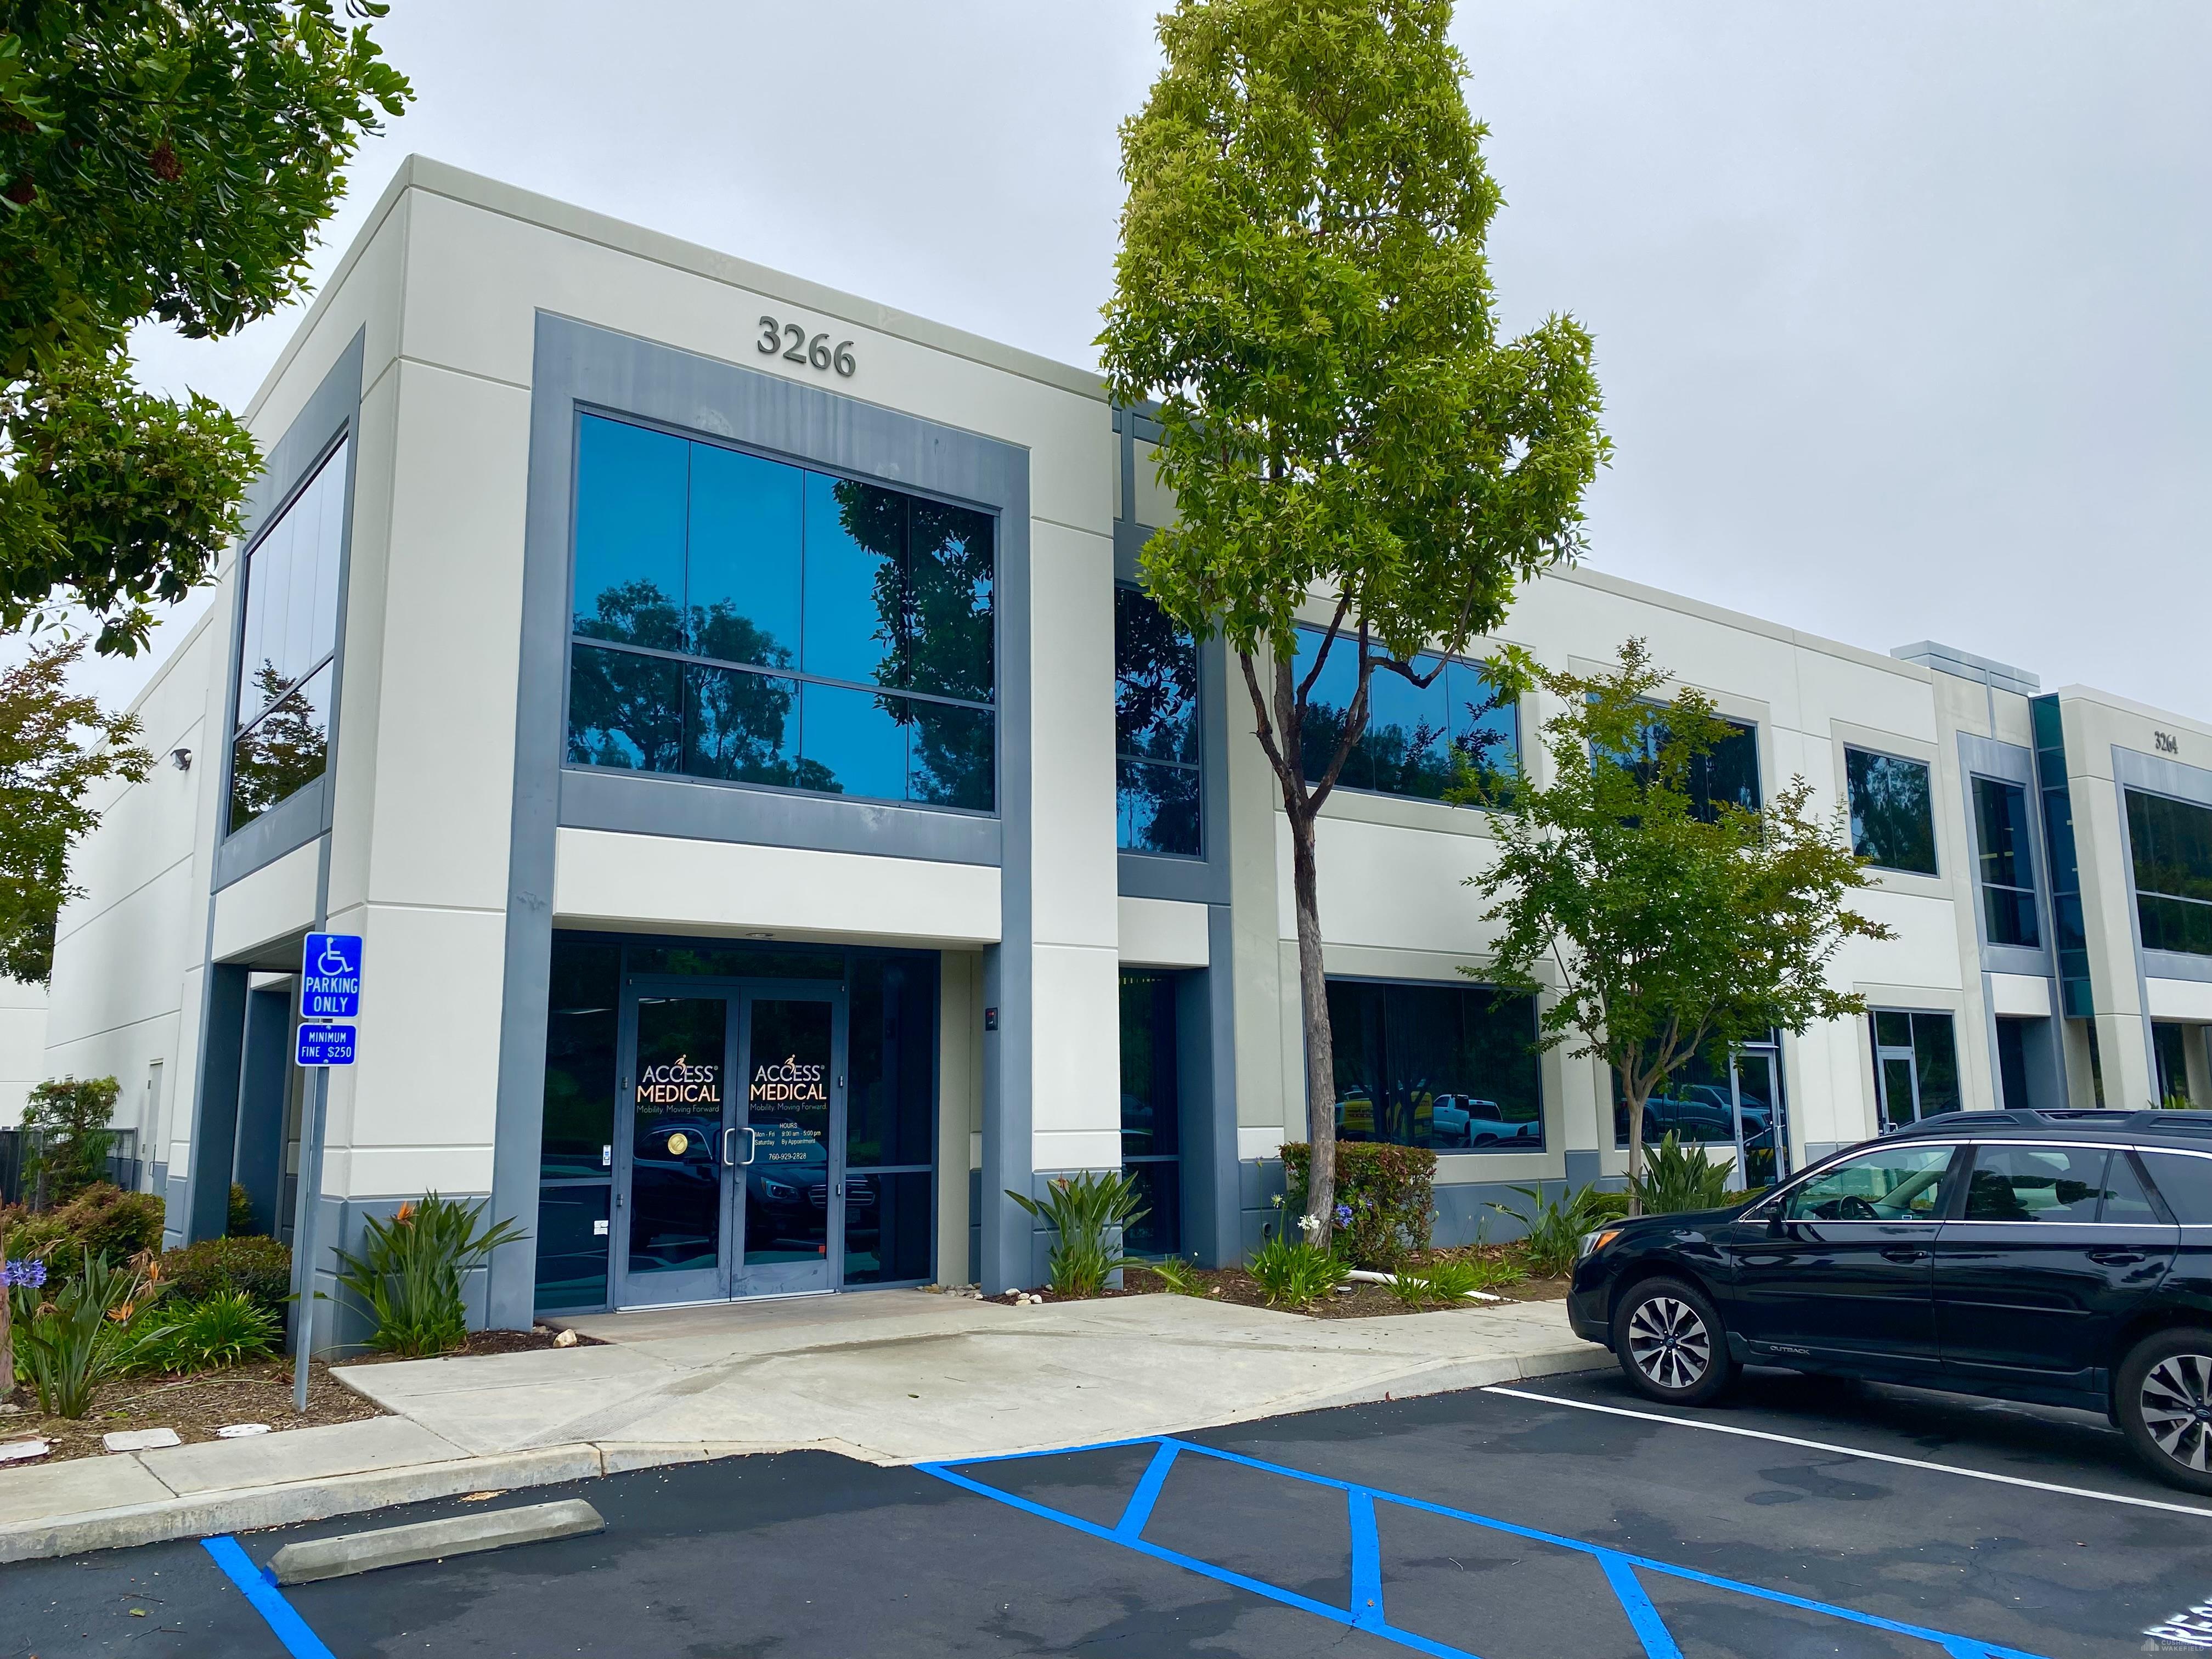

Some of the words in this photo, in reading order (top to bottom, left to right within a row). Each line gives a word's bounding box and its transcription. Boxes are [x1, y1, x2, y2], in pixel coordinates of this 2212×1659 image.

[757, 315, 856, 377] 3266
[2154, 730, 2179, 754] 3264
[306, 977, 358, 994] PARKING
[313, 996, 348, 1013] ONLY
[308, 1032, 346, 1043] MINIMUM
[301, 1046, 320, 1058] FINE
[328, 1046, 352, 1058] $250
[637, 1085, 720, 1102] MEDICAL
[750, 1084, 827, 1101] MEDICAL
[666, 1105, 691, 1114] Moving
[777, 1103, 800, 1112] Moving
[769, 1152, 807, 1160] 760-929-2828
[1770, 1345, 1810, 1355] OUTBACK
